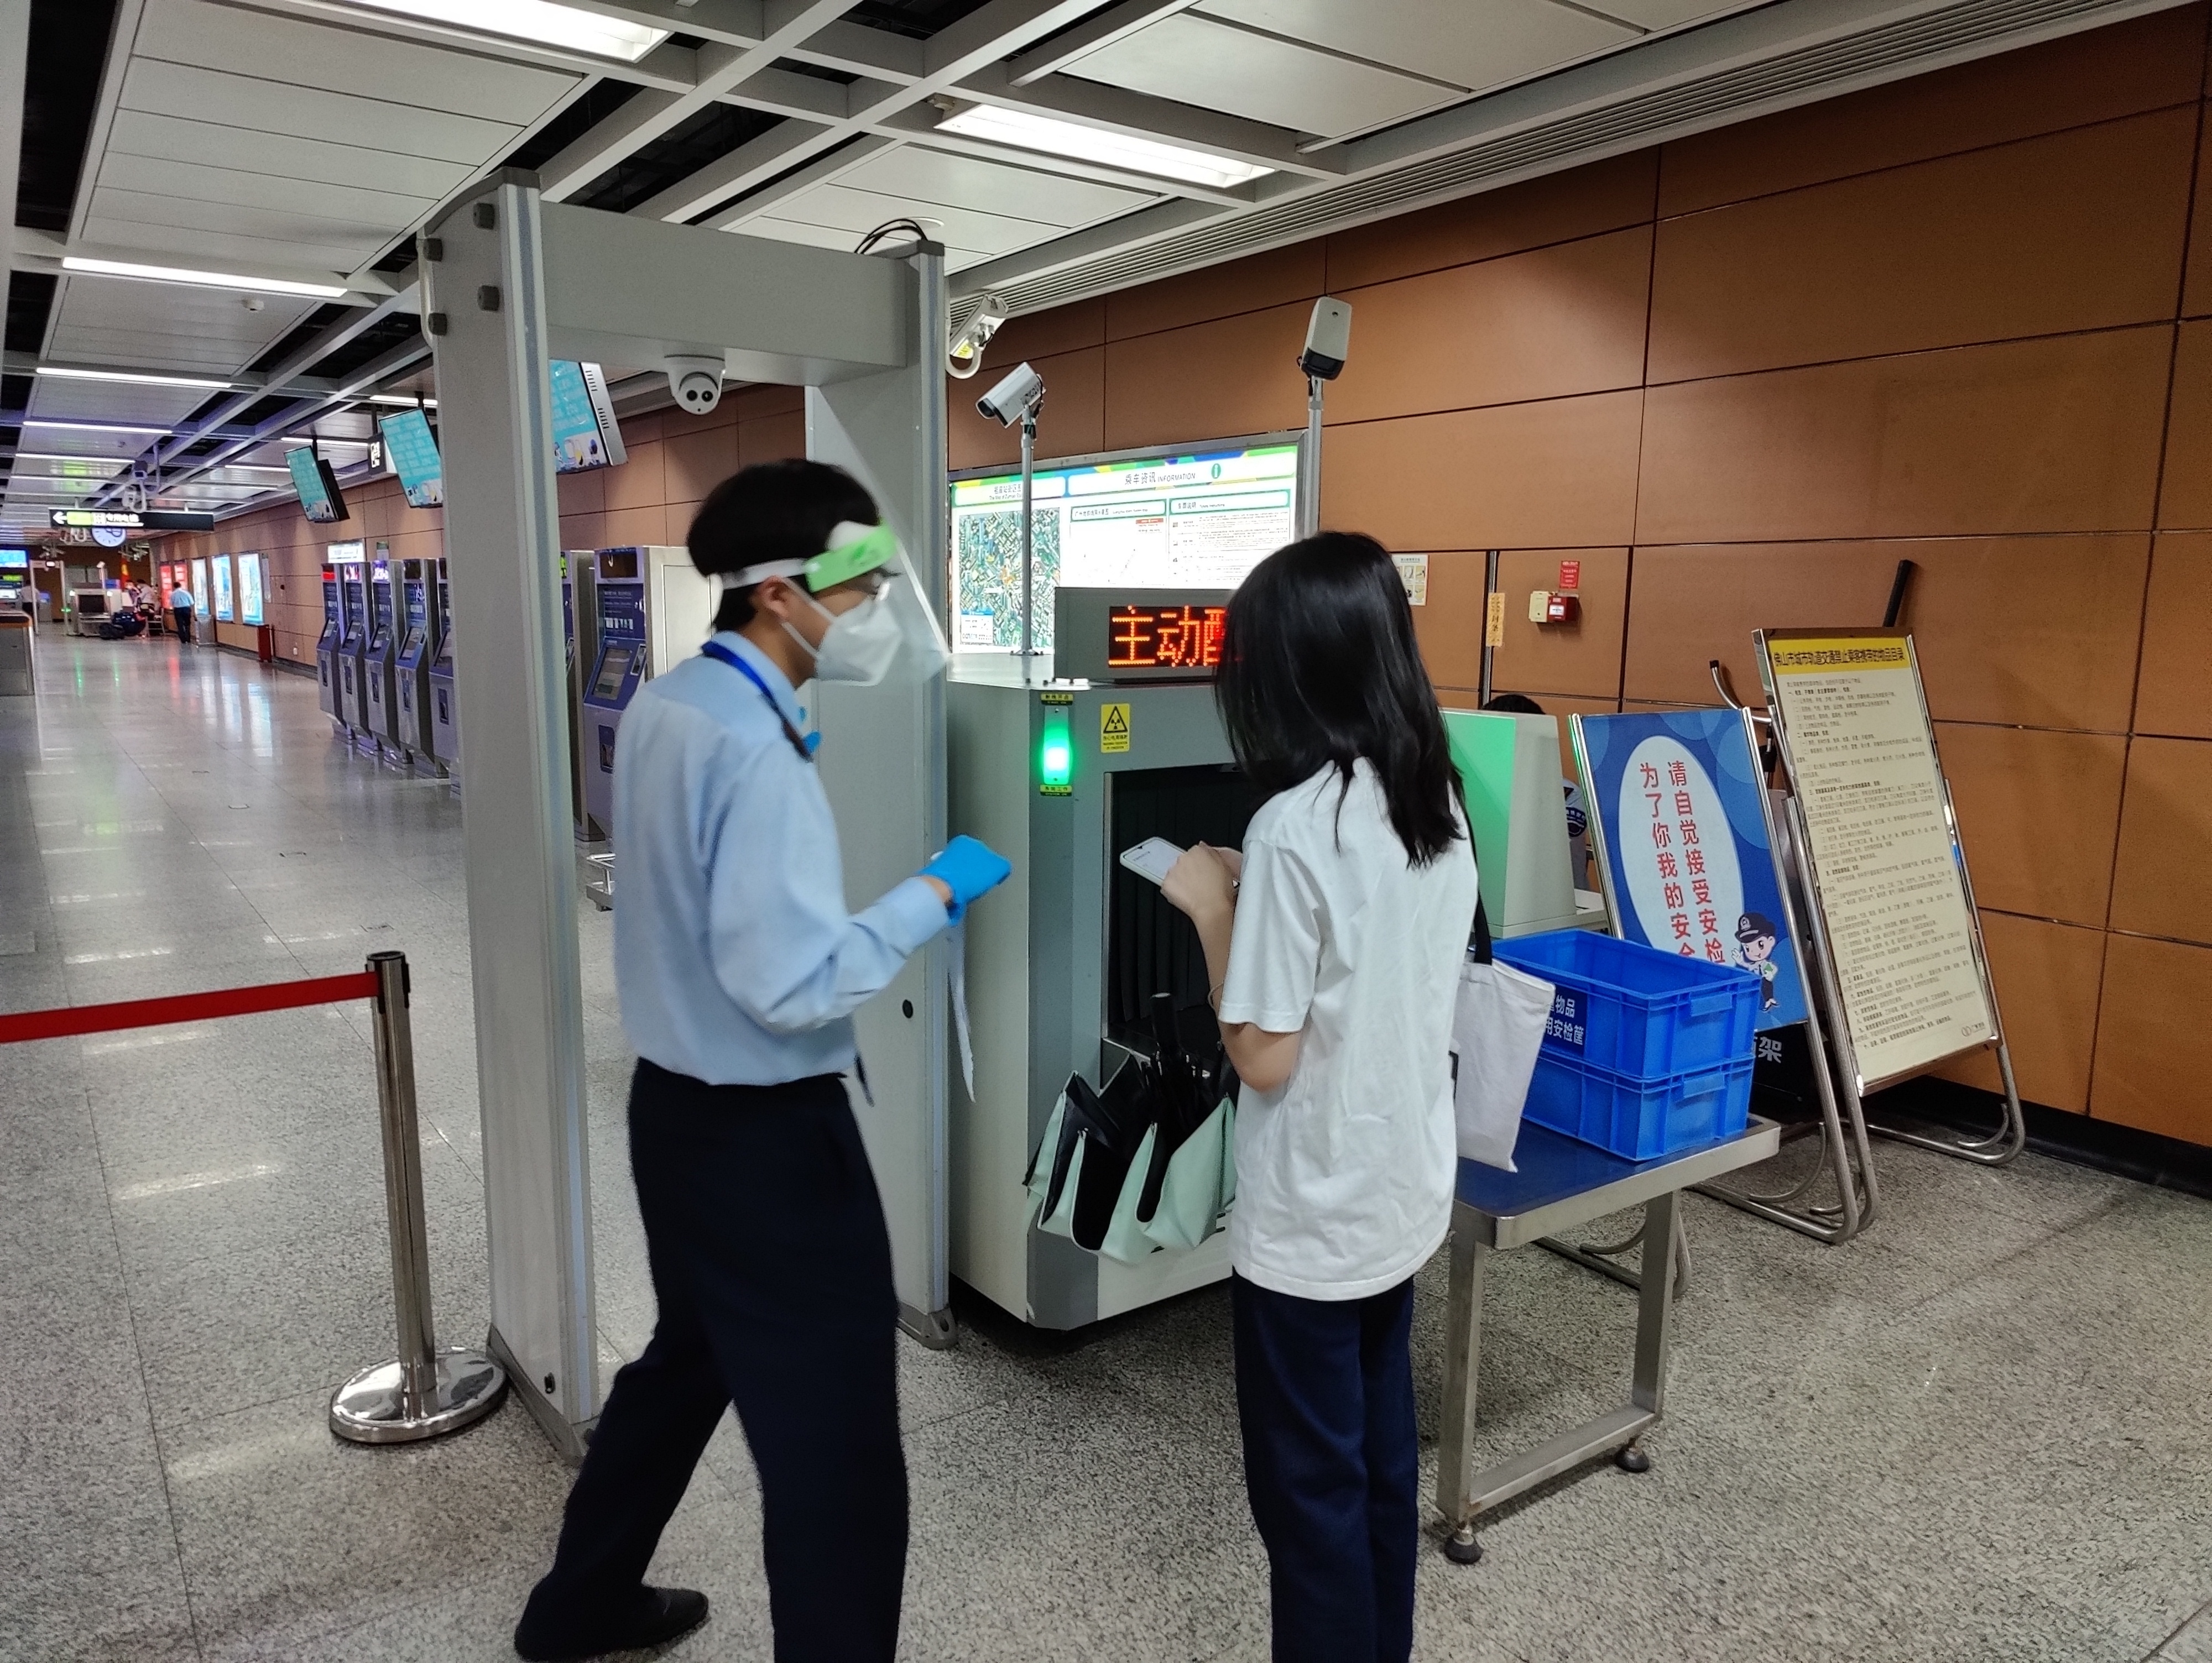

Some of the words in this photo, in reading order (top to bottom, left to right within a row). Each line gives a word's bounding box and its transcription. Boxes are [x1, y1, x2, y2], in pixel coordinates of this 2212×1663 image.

[1125, 472, 1156, 485] 乘车资讯
[1157, 473, 1196, 482] INFORMATION
[1667, 760, 1726, 963] 请自觉接受安检
[1550, 994, 1575, 1018] 物品
[1755, 1036, 1782, 1064] 架
